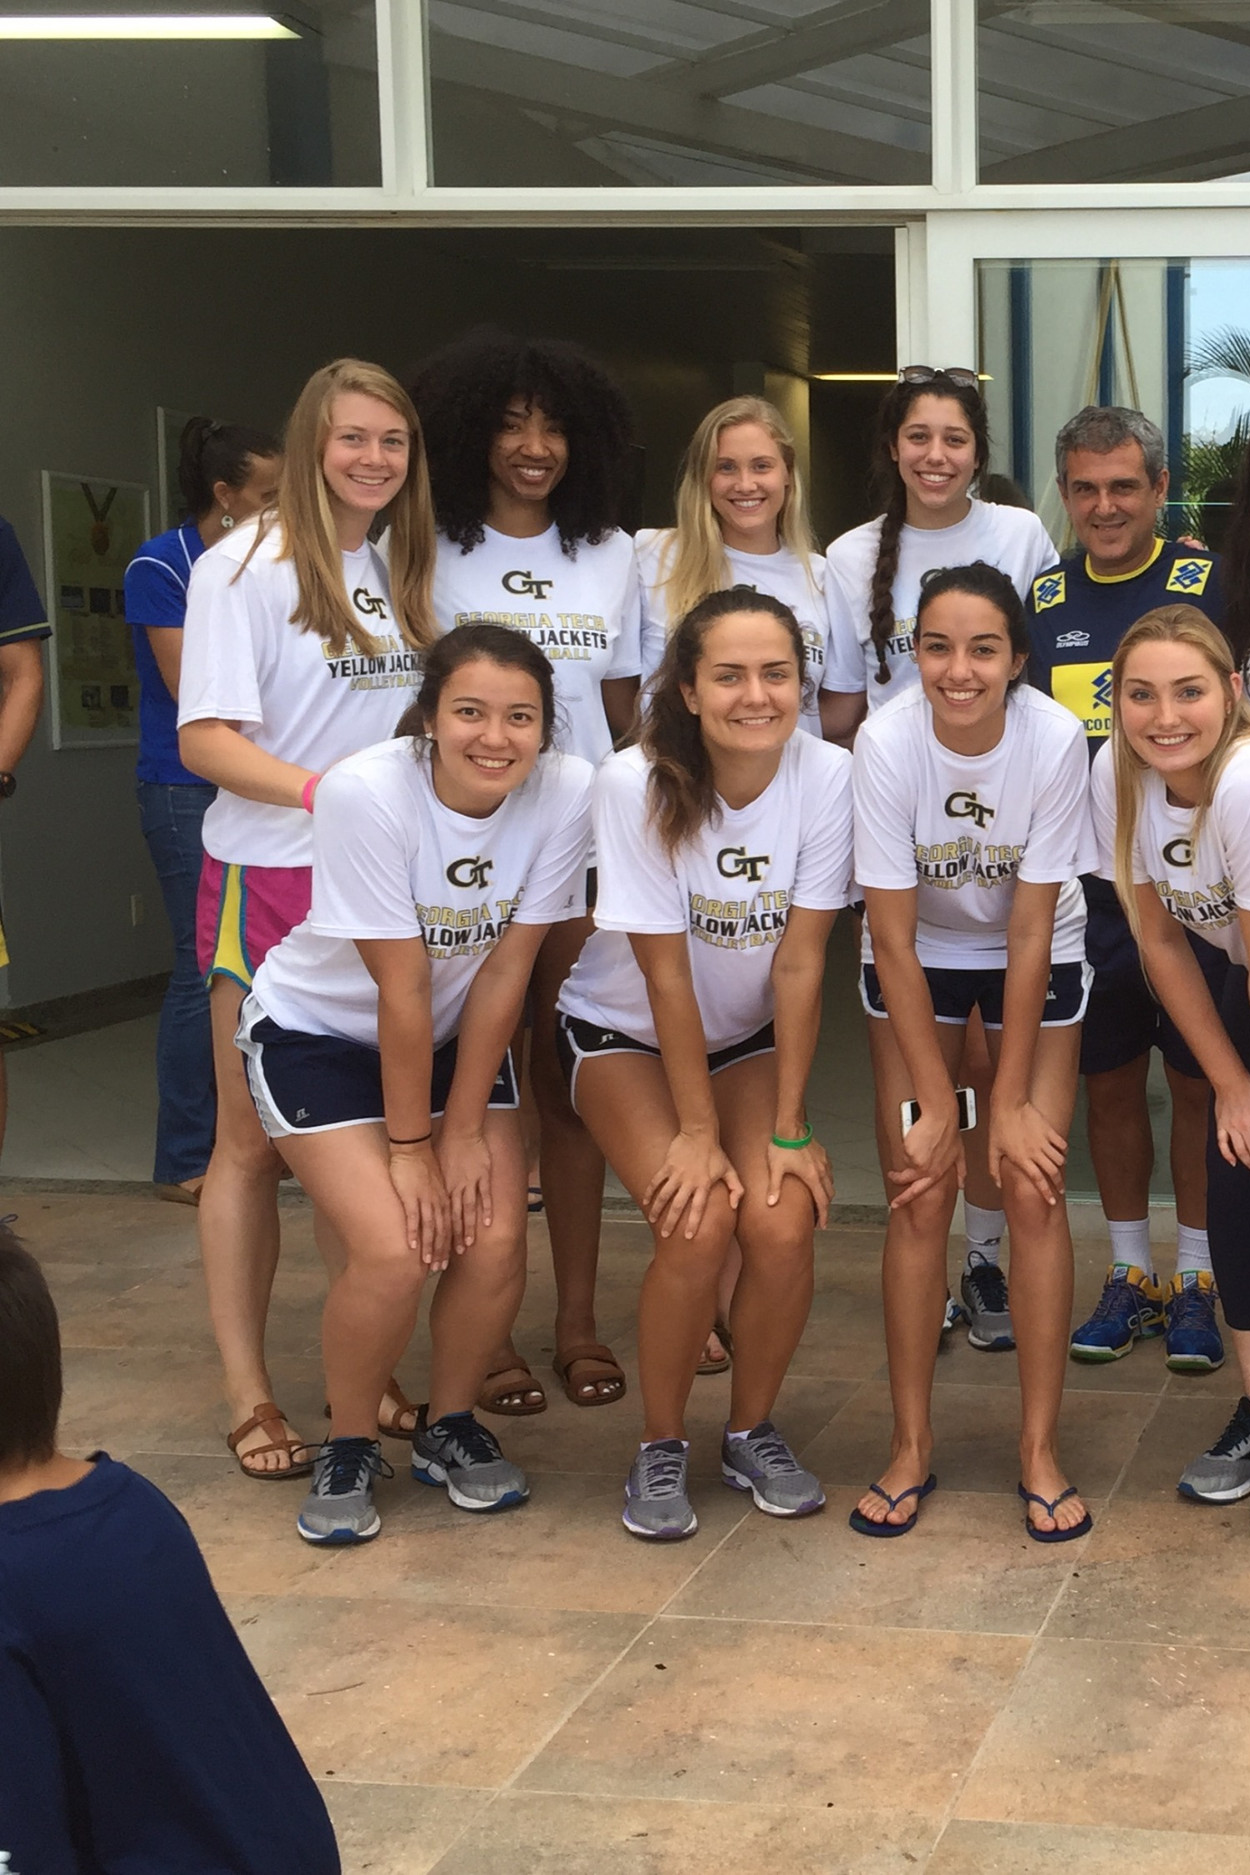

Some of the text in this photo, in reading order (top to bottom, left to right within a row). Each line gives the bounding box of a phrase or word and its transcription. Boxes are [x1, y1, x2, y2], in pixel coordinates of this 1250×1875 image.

[502, 570, 553, 600] GT
[353, 588, 387, 620] GT
[536, 629, 608, 650] JACKETS
[327, 655, 386, 679] YELLOW
[945, 790, 995, 829] GT
[717, 846, 770, 882] GT
[984, 844, 1025, 863] TEC
[446, 855, 494, 890] GT
[415, 902, 493, 929] EORGIA
